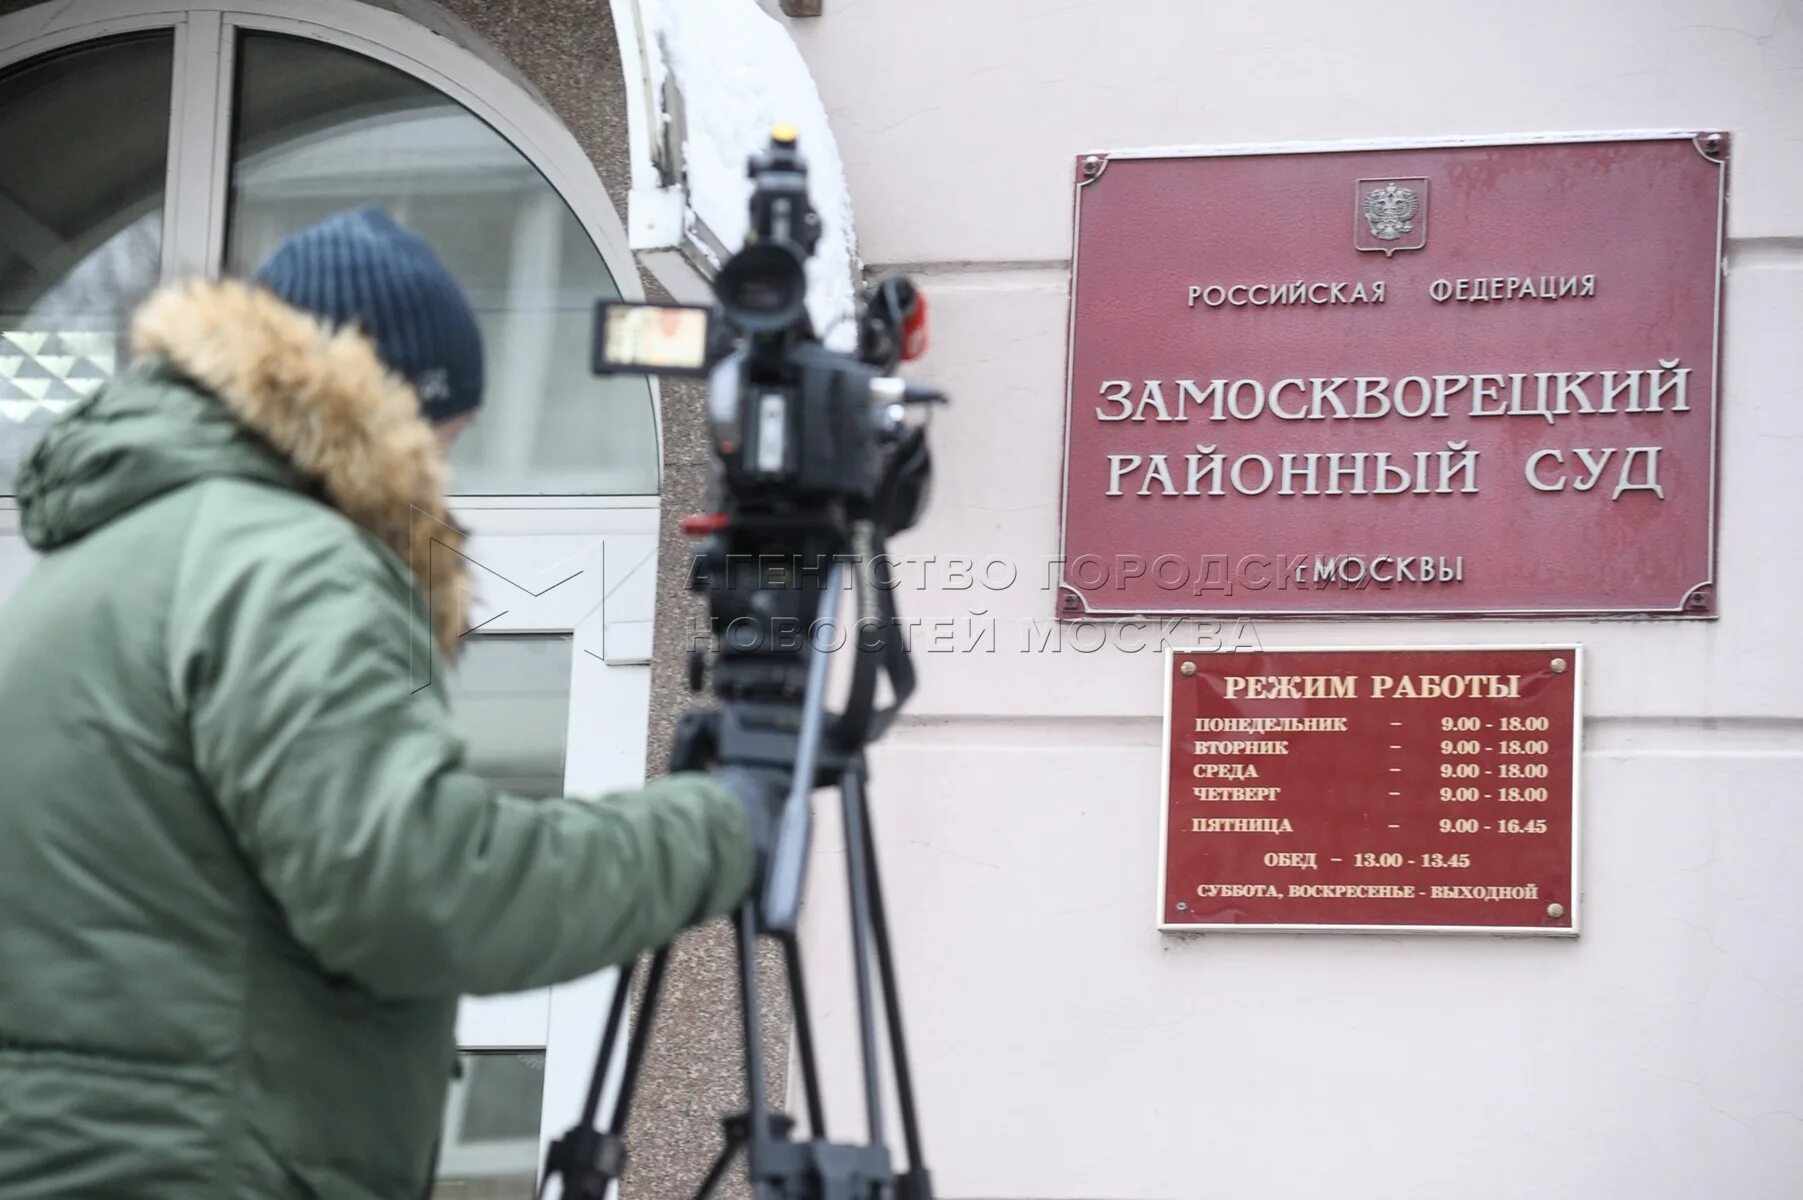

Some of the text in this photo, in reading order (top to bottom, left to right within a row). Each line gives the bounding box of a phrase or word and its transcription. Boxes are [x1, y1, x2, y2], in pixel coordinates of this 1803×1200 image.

[1189, 275, 1596, 305] РОССИЙСКАЯ ФЕДЕРАЦИЯ
[1096, 359, 1691, 423] ЗАМОСКВОРЕЦКИЙ
[1106, 440, 1663, 499] РАЙОННЫЙ СУД
[1224, 675, 1520, 699] РЕЖИМ РАБОТЫ
[1195, 718, 1347, 734] ПОНЕДЕЛЬНИК
[1442, 717, 1480, 731] 9.00
[1500, 717, 1549, 731] 18.00
[1194, 741, 1288, 754] ВТОРНИК
[1441, 741, 1480, 754] 9.00
[1500, 741, 1548, 754] 18.00
[1193, 764, 1259, 780] СРЕДА
[1441, 764, 1479, 778] 9.00
[1499, 764, 1548, 778] 18.00
[1193, 788, 1280, 801] ЧЕТВЕРГ
[1440, 788, 1479, 801] 9.00
[1499, 788, 1547, 801] 18.00
[1192, 819, 1293, 834] ПЯТНИЦА
[1440, 819, 1478, 833] 9.00
[1498, 819, 1547, 833] 16.45
[1264, 853, 1317, 869] ОБЕД
[1355, 853, 1402, 867] 13.00
[1422, 854, 1470, 867] 13.45
[1197, 885, 1283, 898] СУББОТА,
[1289, 885, 1414, 898] ВОСКРЕСЕНЬЕ
[1431, 884, 1537, 901] ВЫХОДНОЙ
